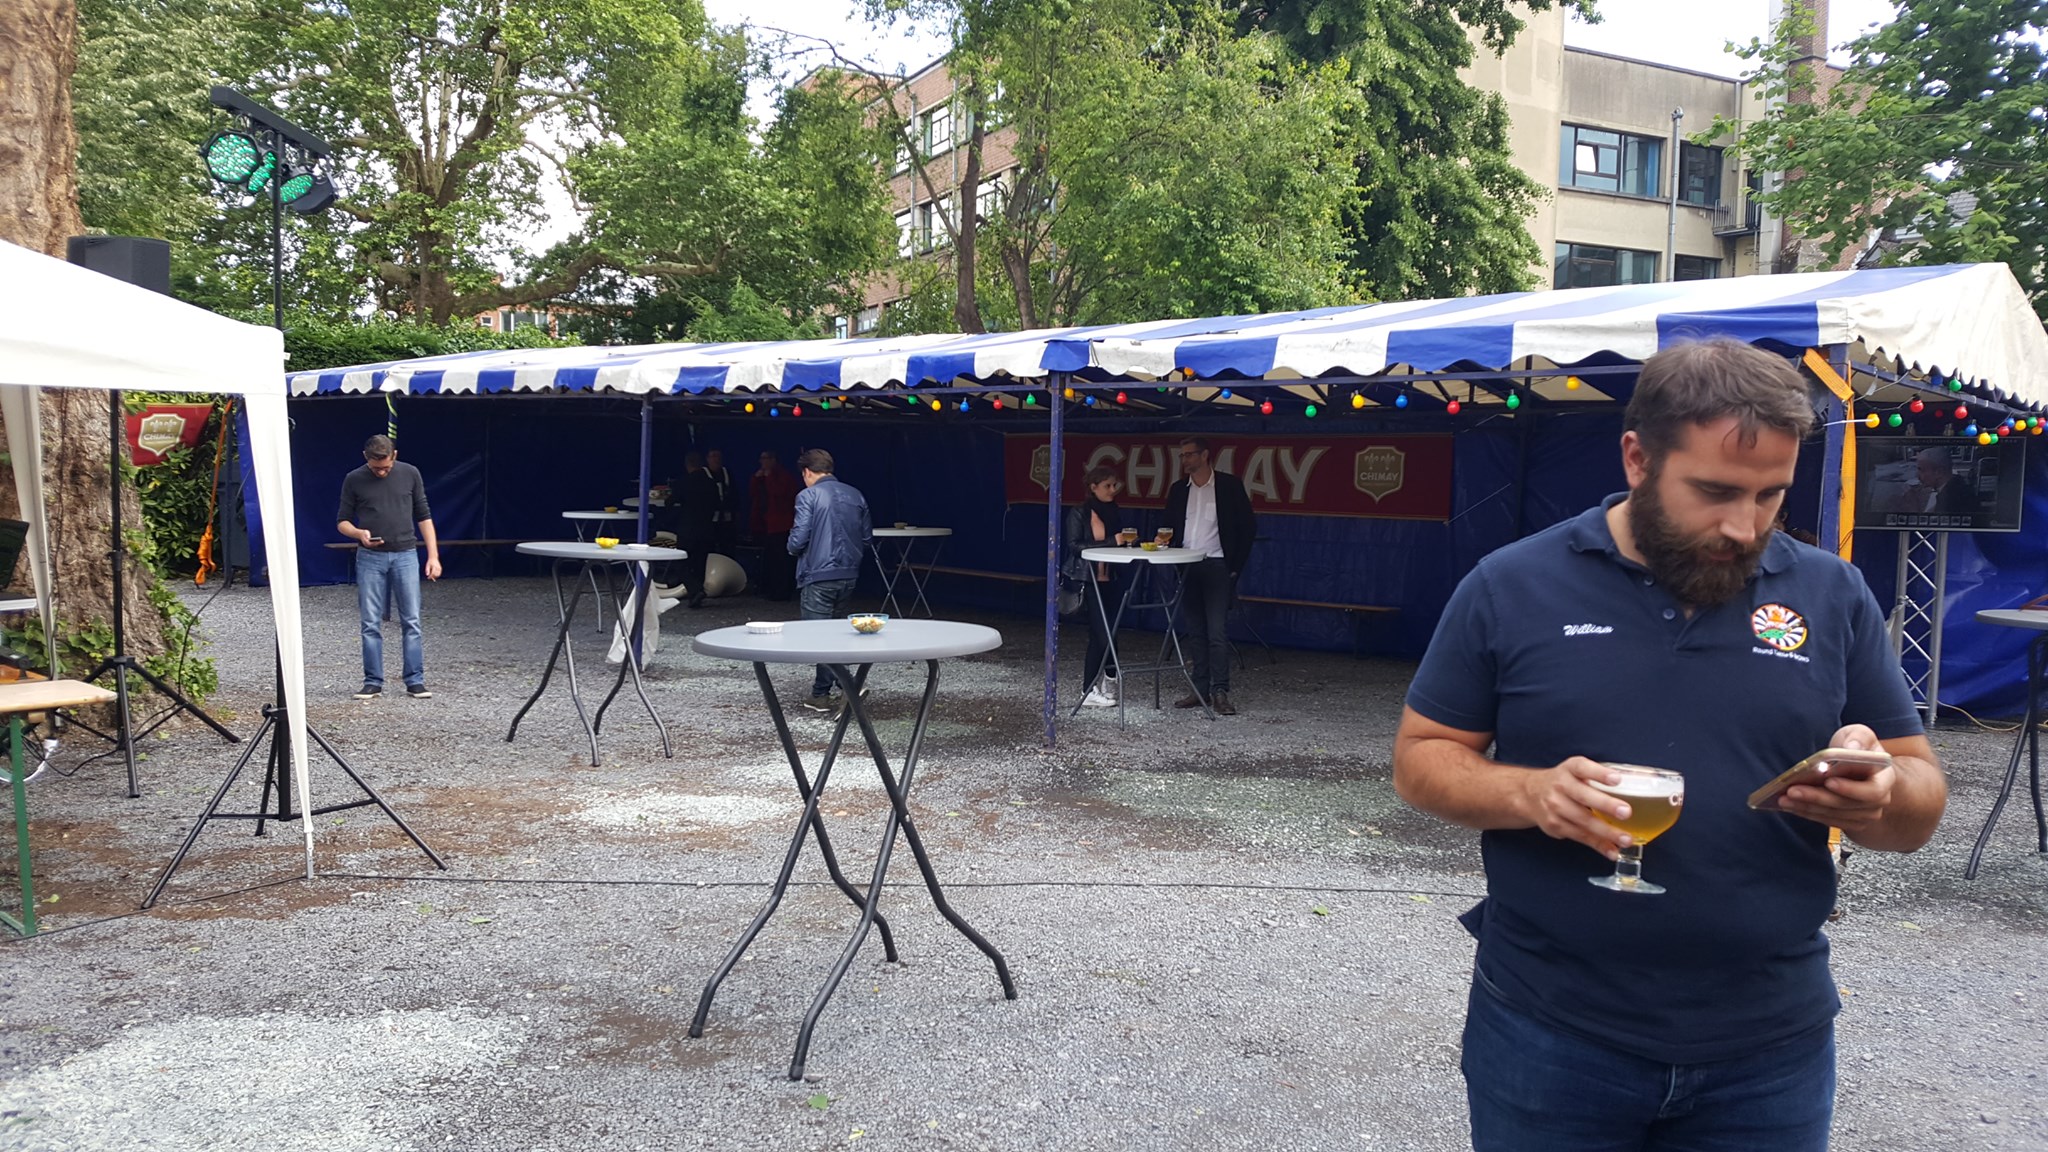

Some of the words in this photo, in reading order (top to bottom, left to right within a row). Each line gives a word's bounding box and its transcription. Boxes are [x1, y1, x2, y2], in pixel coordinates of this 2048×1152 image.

[1084, 443, 1331, 503] CHIAY
[1360, 471, 1400, 481] CHIMAY
[1563, 623, 1614, 636] William
